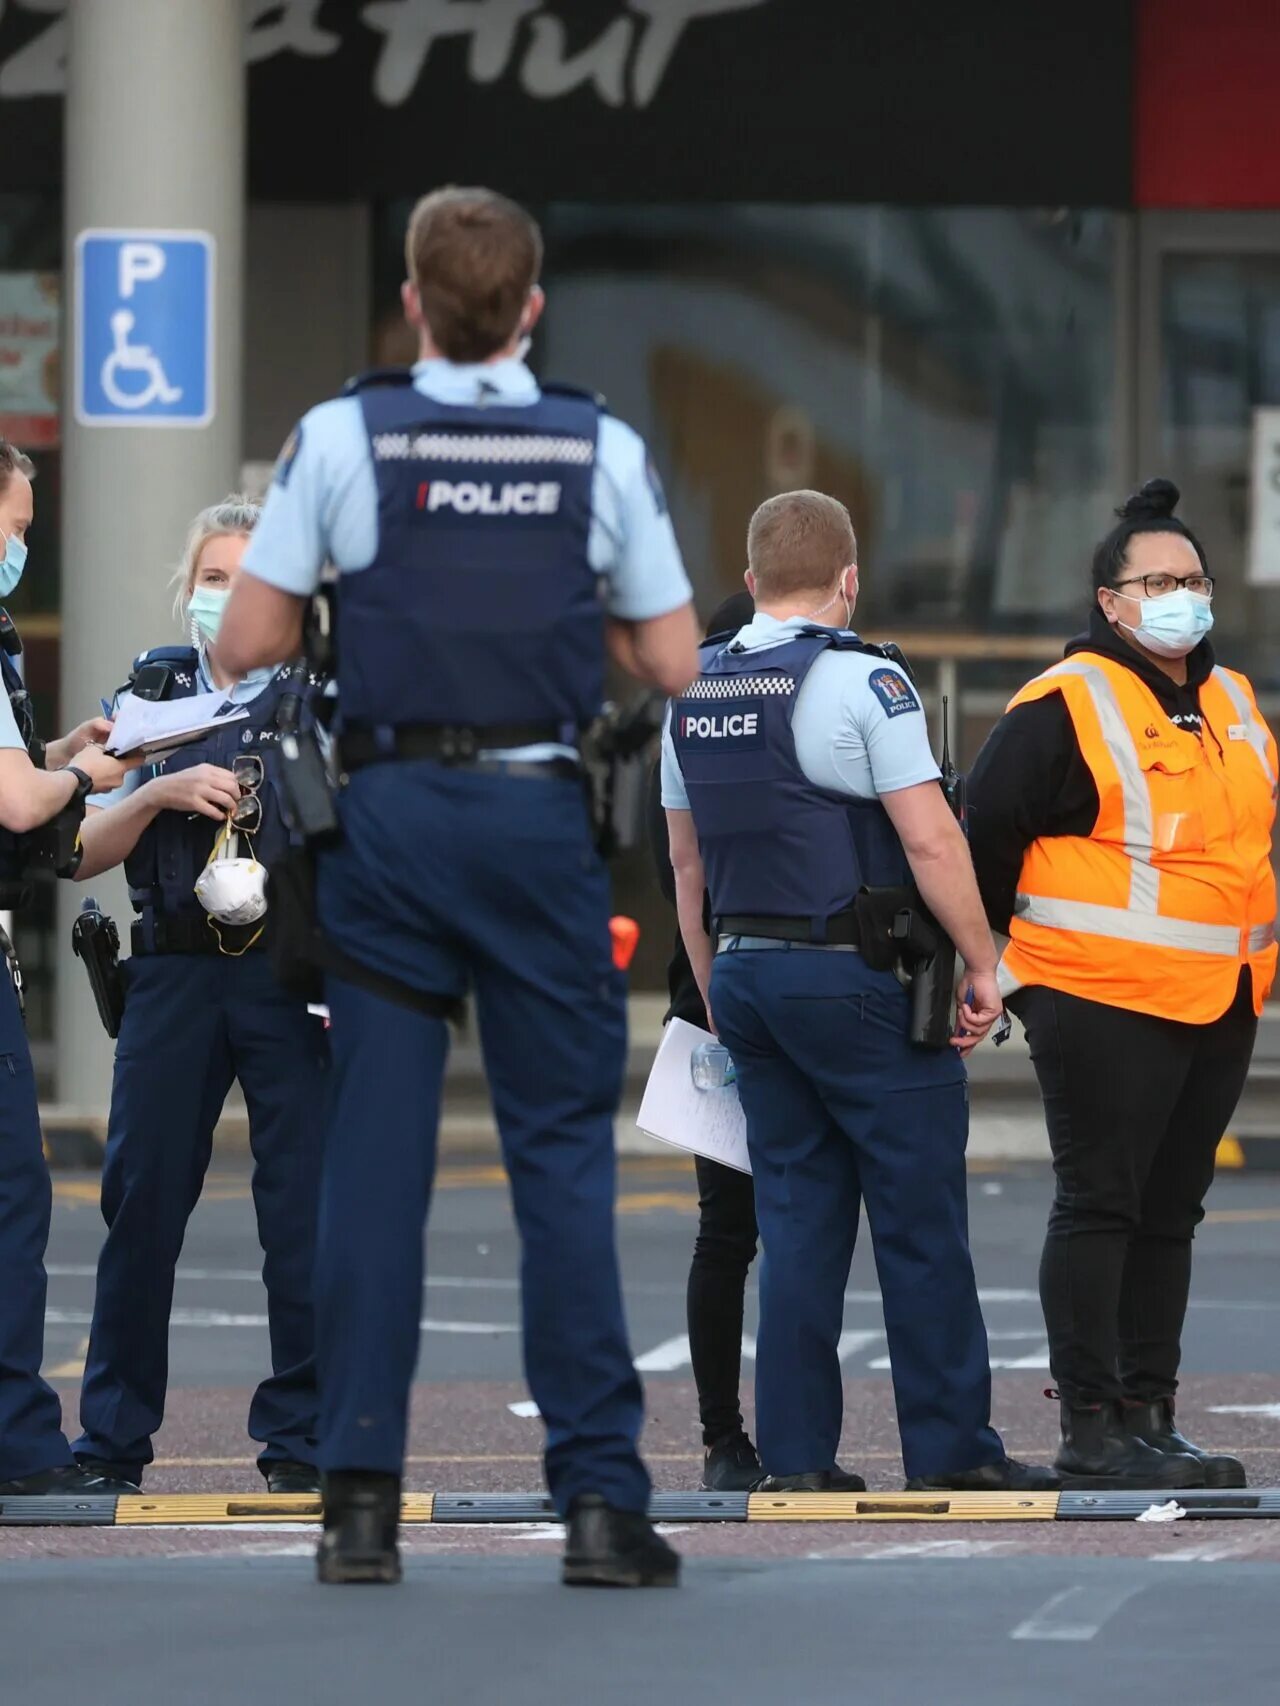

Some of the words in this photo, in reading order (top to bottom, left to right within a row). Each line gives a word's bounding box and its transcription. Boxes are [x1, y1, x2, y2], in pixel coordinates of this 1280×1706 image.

[360, 0, 768, 107] Hut
[118, 243, 166, 299] P
[427, 480, 562, 515] POLICE
[889, 700, 917, 713] POLICE
[686, 713, 758, 738] POLICE
